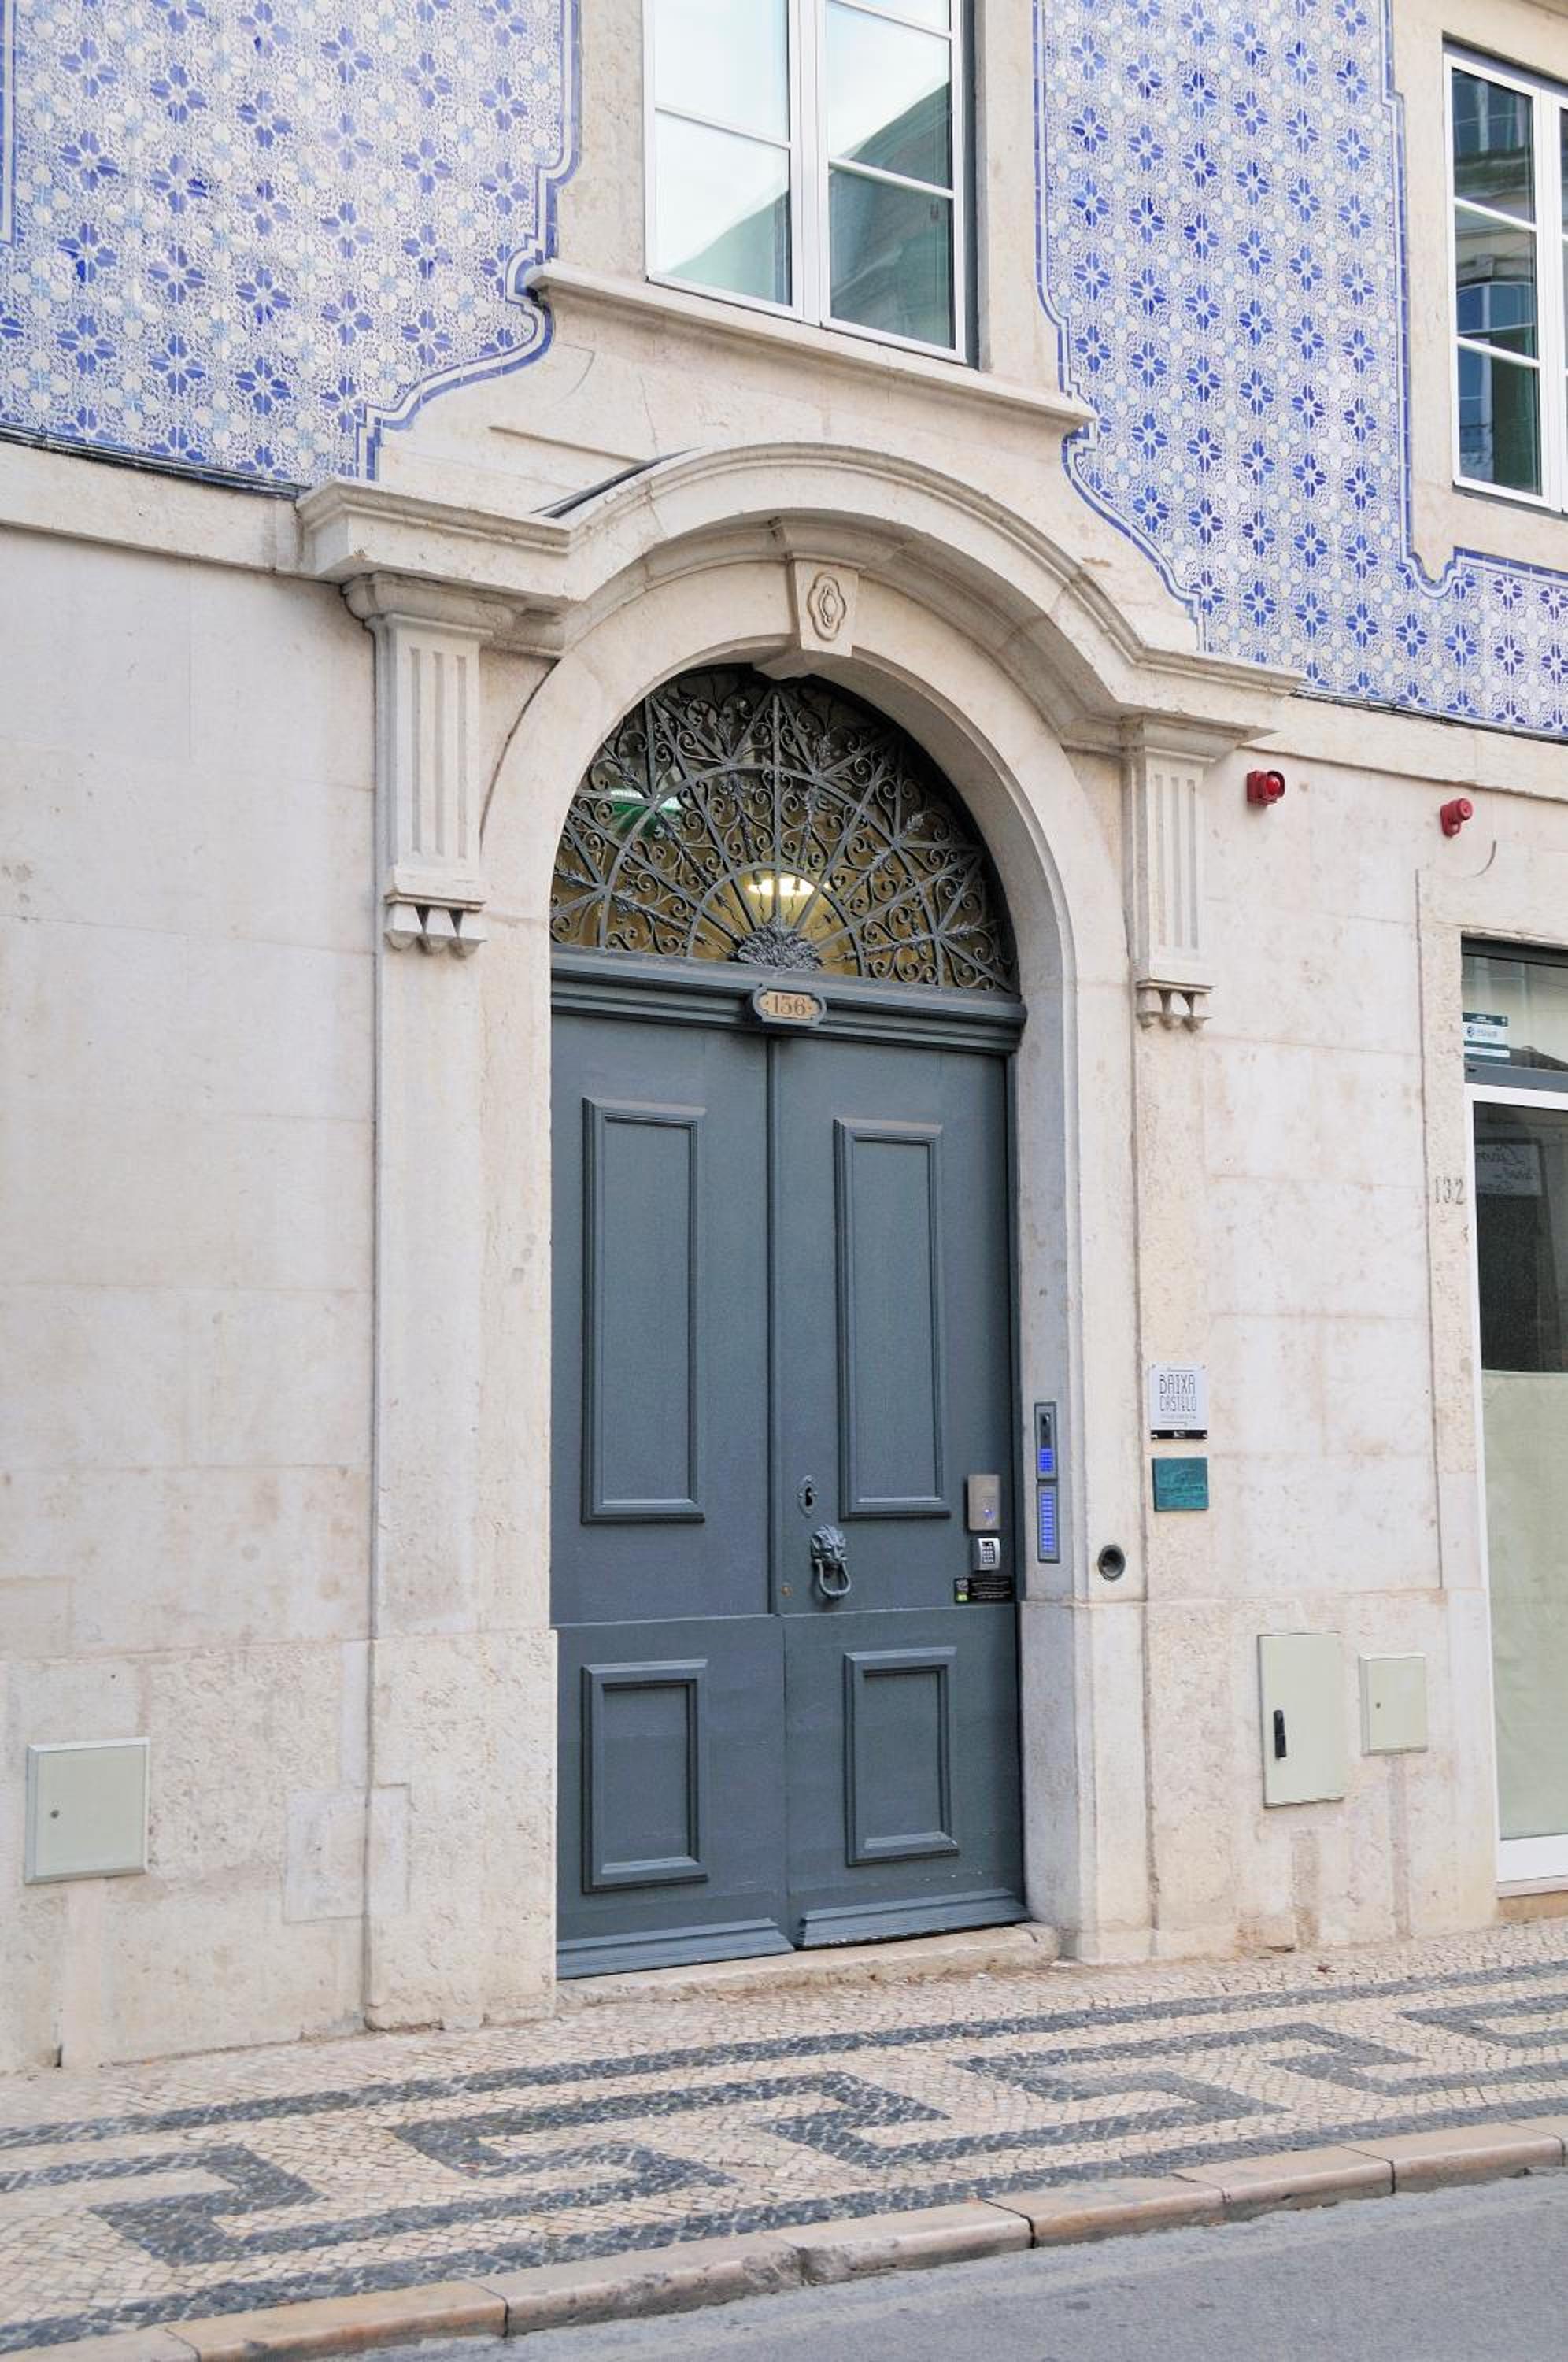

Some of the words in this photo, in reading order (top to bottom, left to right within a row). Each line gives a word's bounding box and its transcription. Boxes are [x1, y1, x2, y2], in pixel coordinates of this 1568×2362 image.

[1435, 1175, 1464, 1205] 132
[1159, 1374, 1196, 1394] BAIXA
[1159, 1394, 1197, 1412] CASTELO
